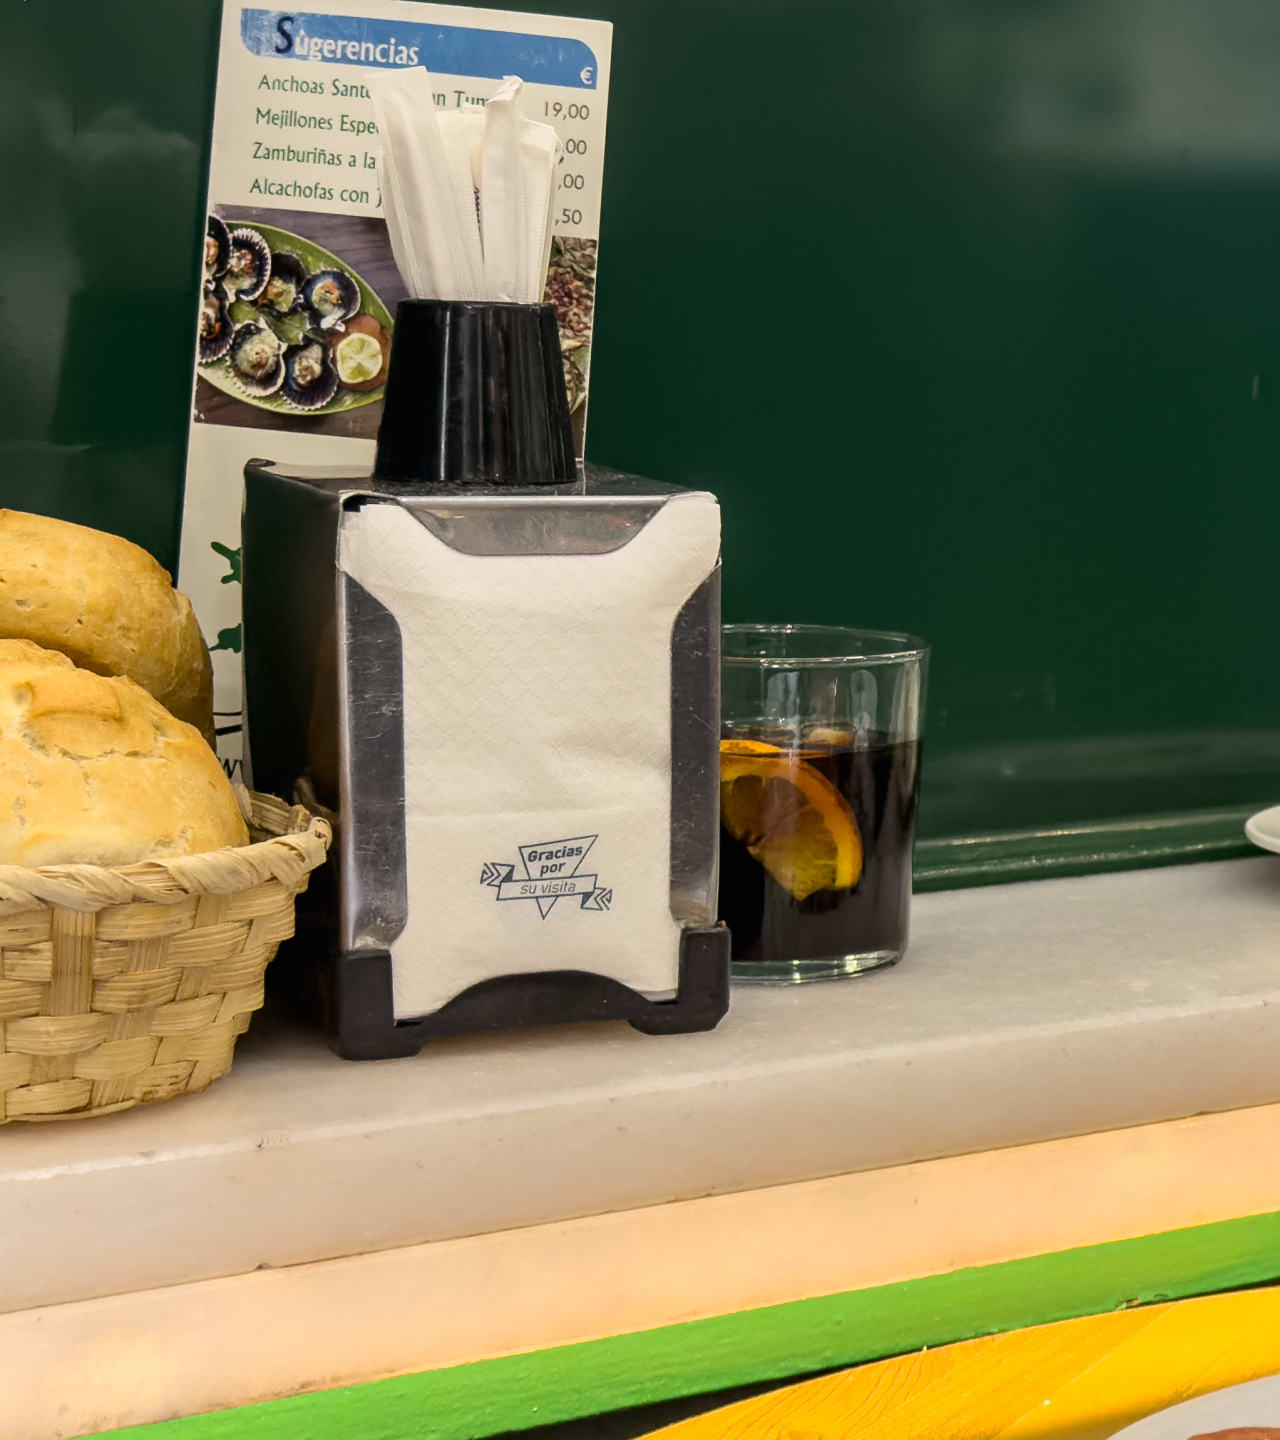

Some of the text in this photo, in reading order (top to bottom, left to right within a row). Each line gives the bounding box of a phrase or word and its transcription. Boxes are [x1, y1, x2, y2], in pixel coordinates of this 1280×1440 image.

[275, 16, 420, 66] Sugerencias
[258, 74, 325, 95] Anchoas
[544, 102, 590, 121] 19,00
[255, 106, 333, 130] Mejillones
[340, 114, 379, 136] Espe
[252, 141, 585, 190] Zamburiñas a la ,00
[249, 177, 334, 201] Alcachofas
[340, 188, 369, 204] con
[554, 208, 582, 226] ,50
[527, 846, 583, 863] Gracias
[540, 862, 566, 877] por
[520, 881, 577, 895] su visita
